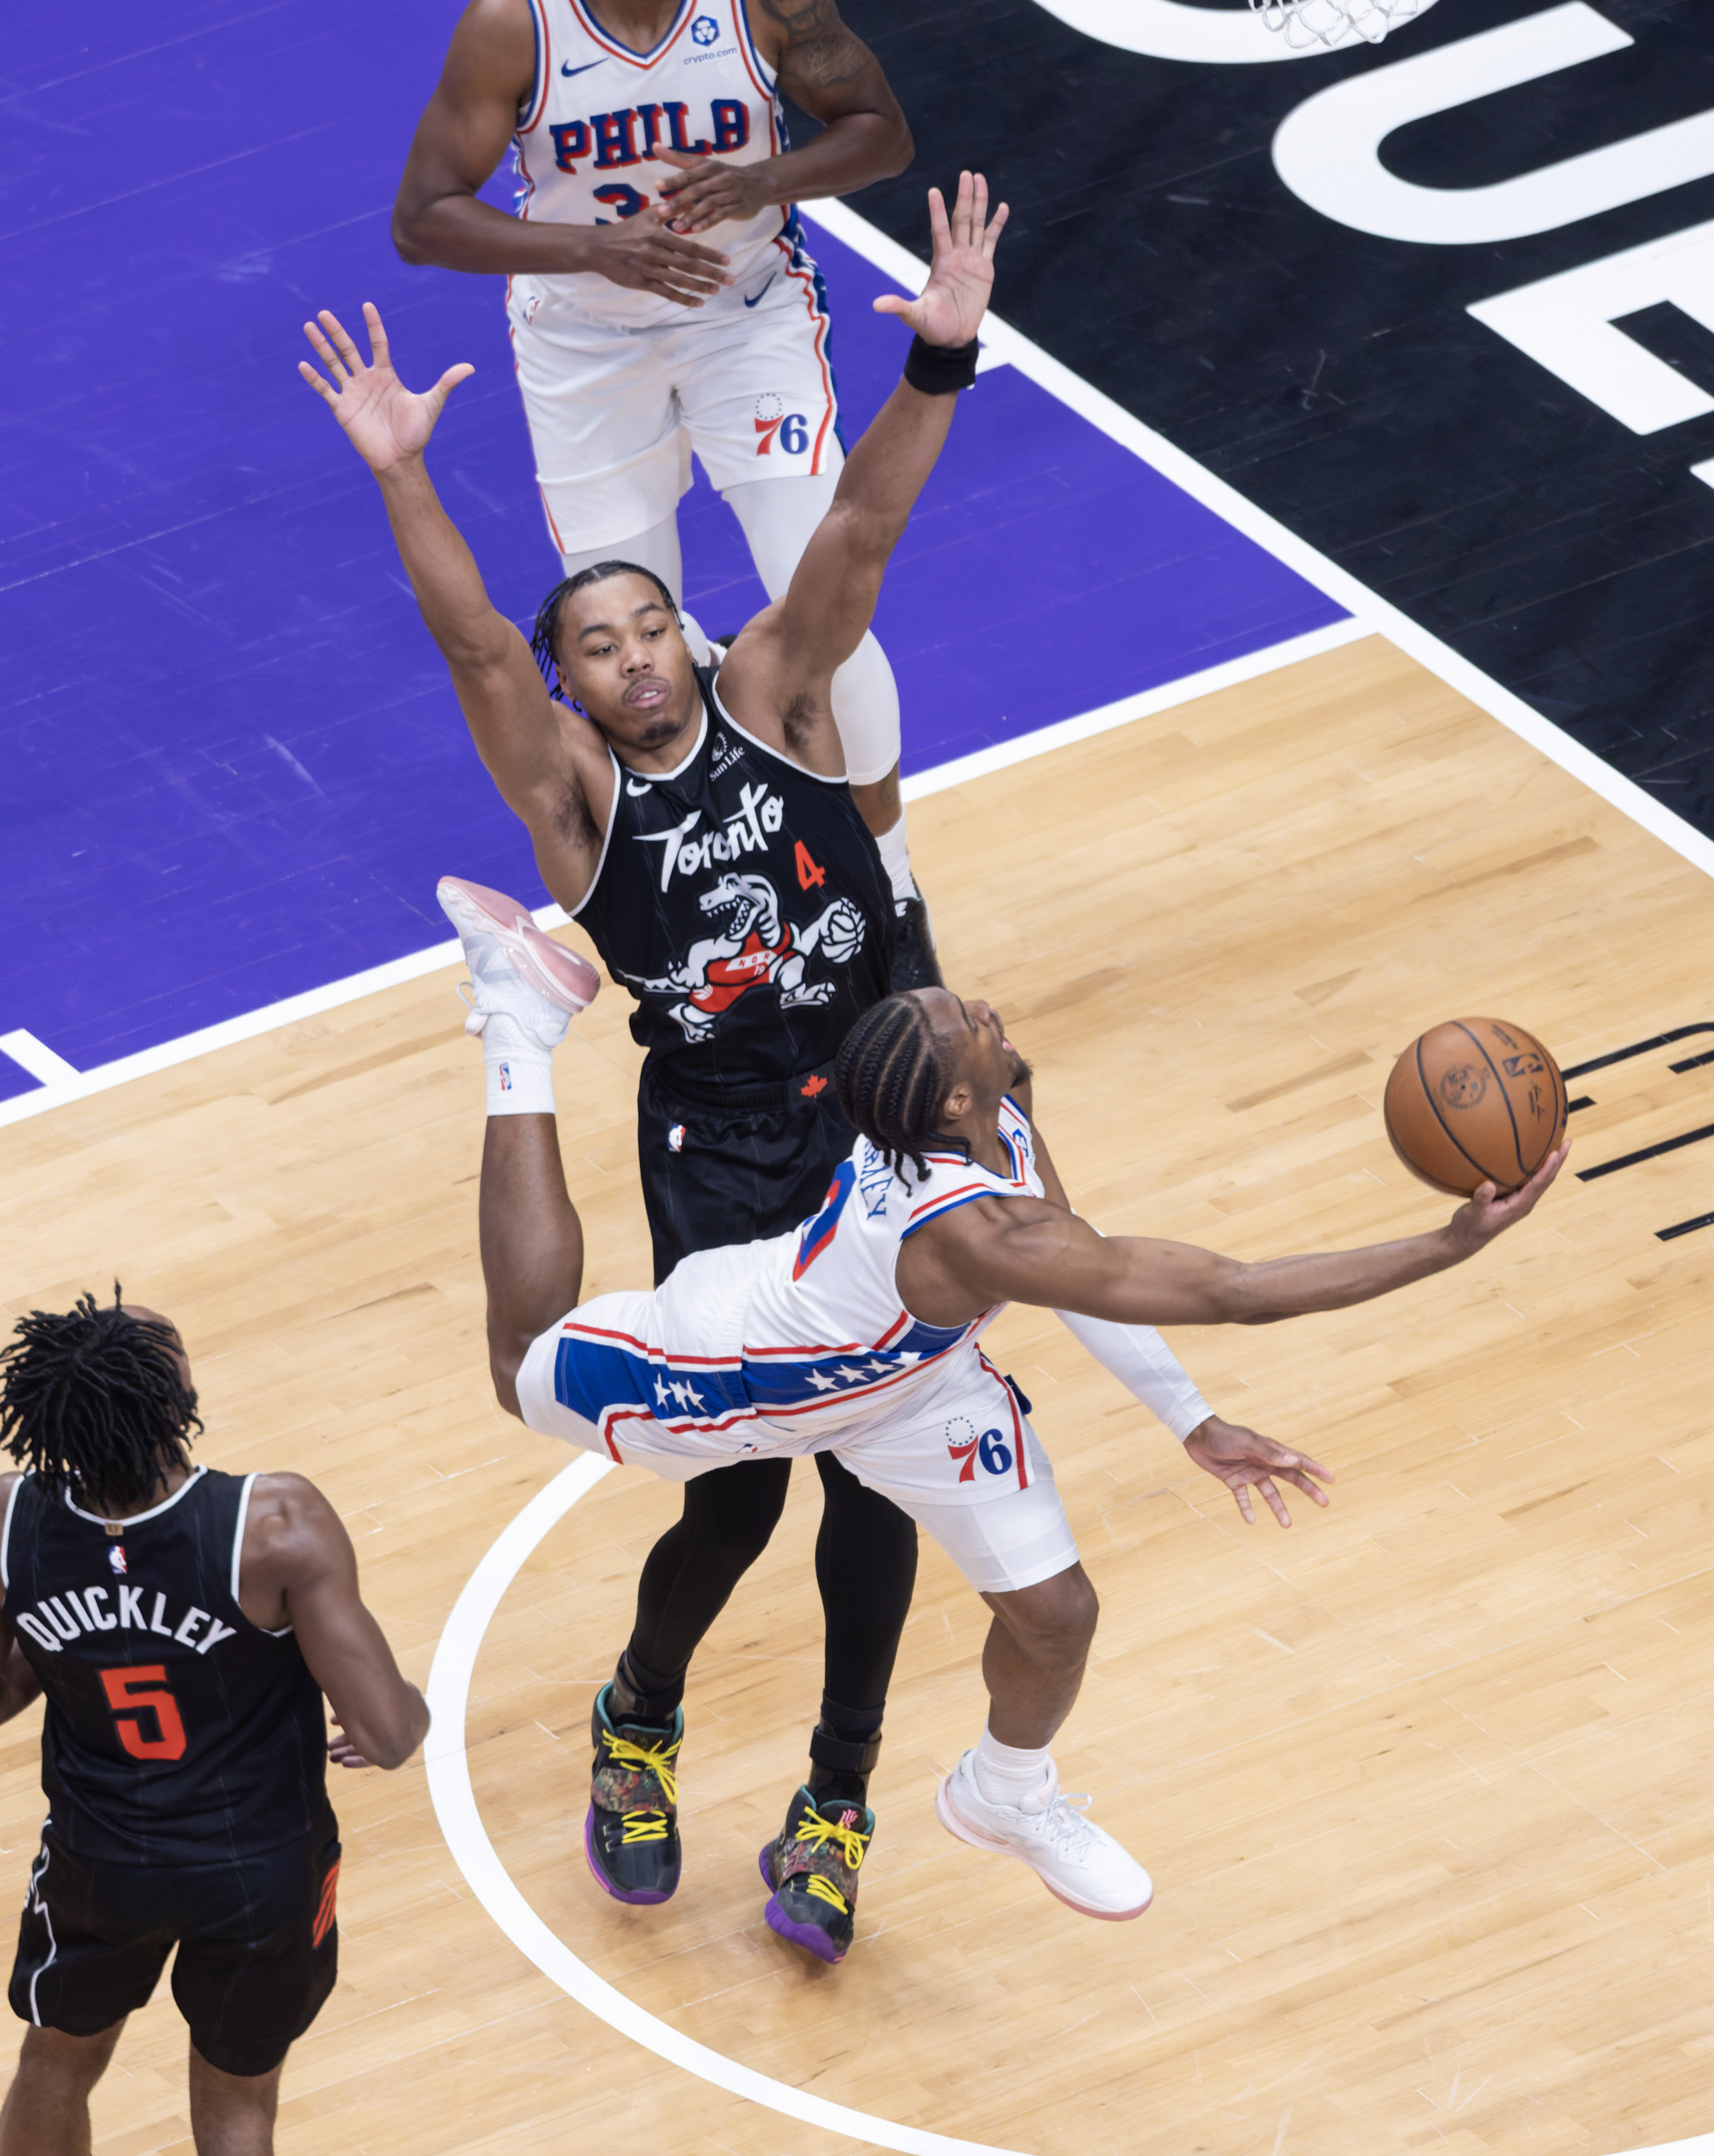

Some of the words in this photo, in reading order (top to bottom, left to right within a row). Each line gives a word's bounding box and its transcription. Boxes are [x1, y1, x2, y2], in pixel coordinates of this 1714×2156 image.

[683, 47, 738, 65] crypto.com
[549, 98, 751, 175] PHILA
[754, 413, 810, 457] 76
[709, 762, 728, 782] Sun
[724, 746, 745, 766] Life
[632, 783, 784, 893] Toronto
[794, 840, 826, 891] 4
[947, 1428, 1012, 1483] 76
[16, 1584, 237, 1655] QUICKLEY
[99, 1664, 188, 1761] 5
